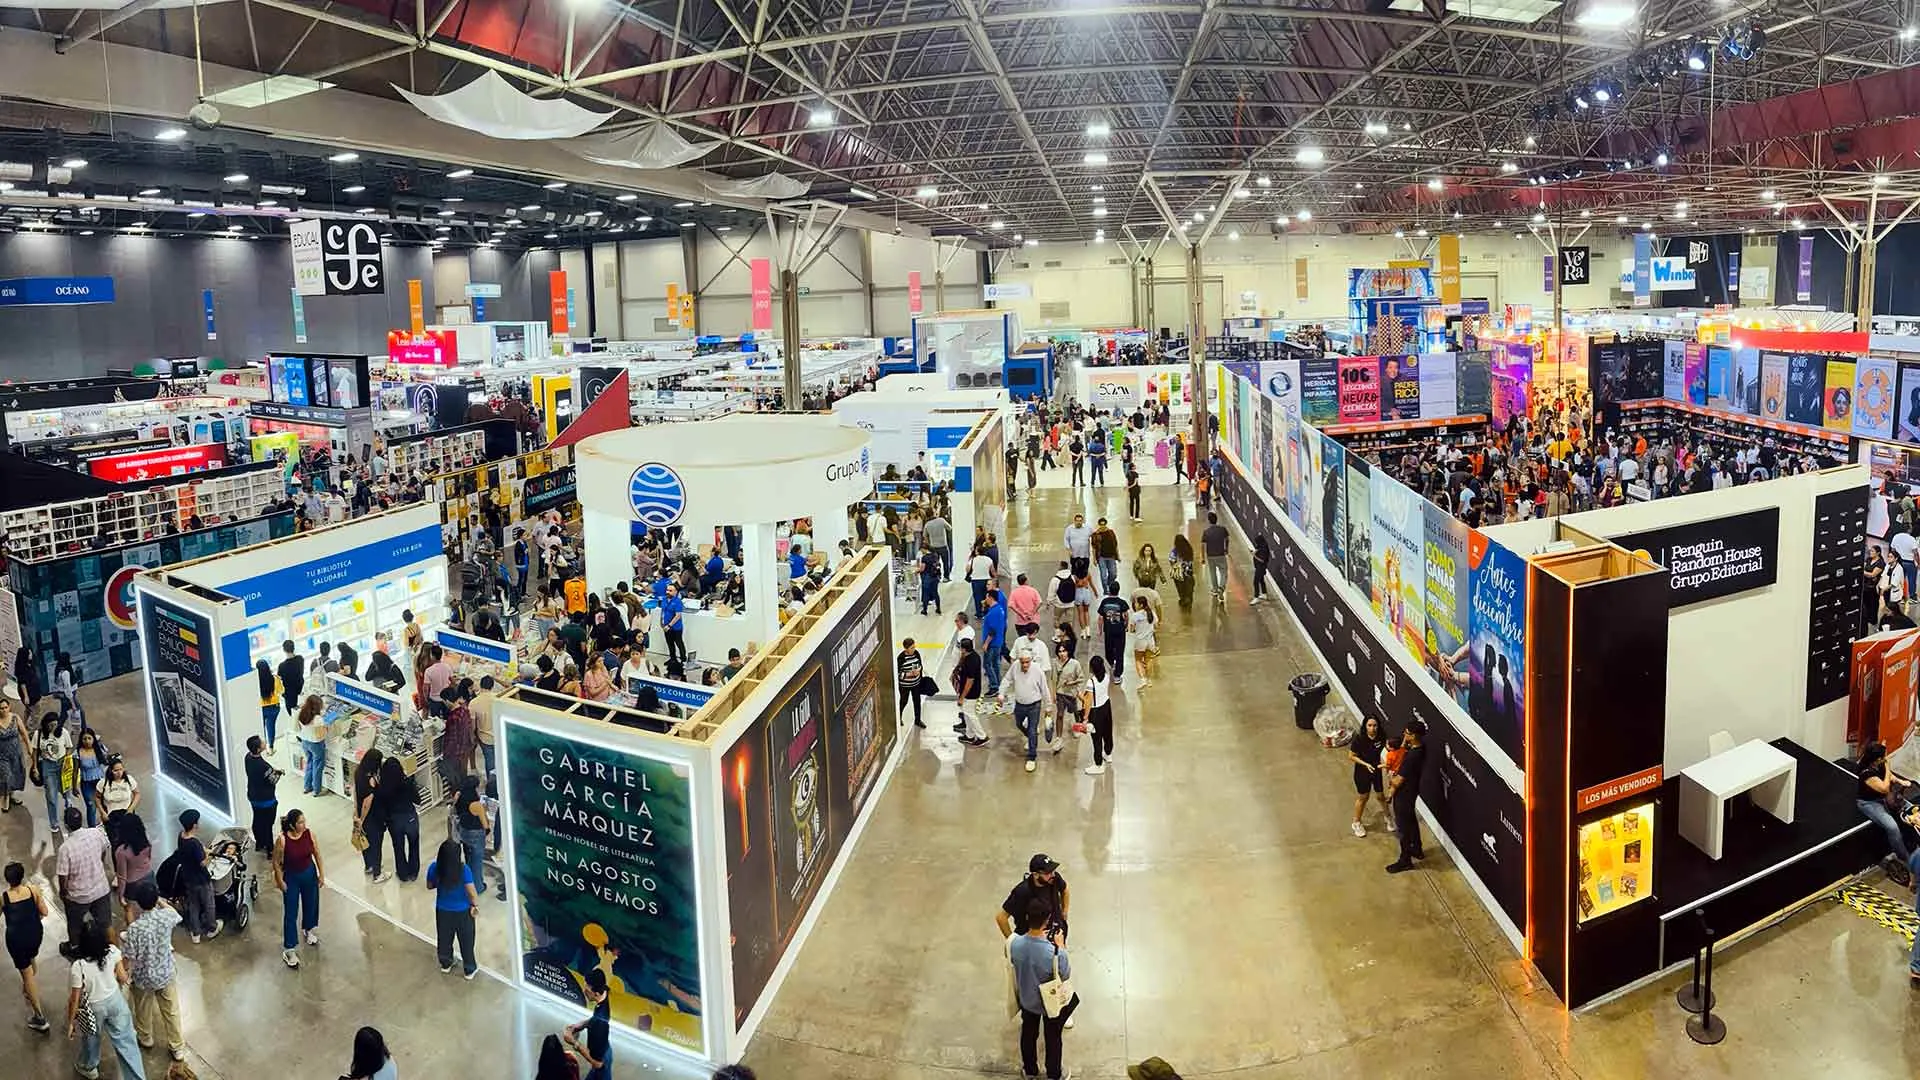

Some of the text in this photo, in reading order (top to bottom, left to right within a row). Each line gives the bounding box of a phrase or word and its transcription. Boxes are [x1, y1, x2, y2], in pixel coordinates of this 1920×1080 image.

[293, 231, 320, 249] EDUCAL
[1304, 380, 1336, 388] HERIDAS
[1304, 390, 1337, 398] INFANCIA
[1394, 381, 1418, 389] PADRE
[1394, 388, 1419, 398] RICO
[826, 459, 861, 481] Grupo
[1425, 540, 1456, 576] CÓMO
[1671, 538, 1724, 560] Penguin
[1671, 546, 1762, 575] Random House
[312, 570, 348, 587] SALUDABLE
[317, 559, 353, 576] BIBLIOTECA
[1426, 559, 1456, 595] GANAR
[1480, 551, 1517, 599] Antes
[1670, 556, 1763, 590] Grupo Editorial
[1473, 579, 1524, 643] diciembre
[157, 617, 179, 636] JOSÉ
[158, 632, 185, 654] EMILIO
[160, 648, 202, 676] PACHECO
[667, 688, 684, 698] CON
[539, 746, 652, 792] GABRIEL
[541, 772, 653, 820] GARCÍA
[1585, 773, 1657, 805] LOS MÁS VENDIDOS
[543, 799, 655, 847] MÁRQUEZ
[544, 826, 656, 867] PREMIO NOBEL DE LITERATURA
[545, 845, 657, 892] EN AGOSTO
[547, 867, 659, 915] NOS VEMOS
